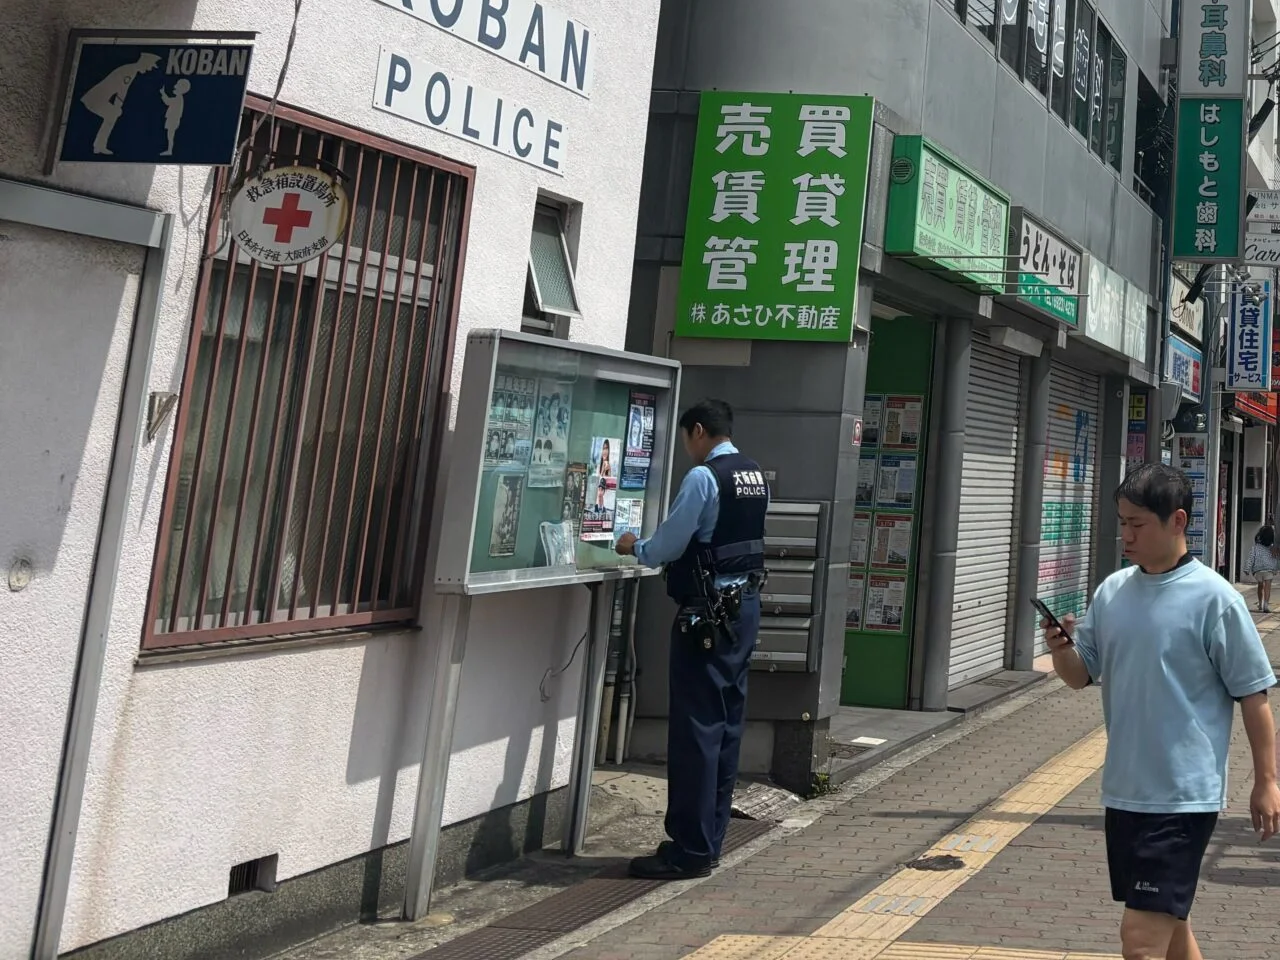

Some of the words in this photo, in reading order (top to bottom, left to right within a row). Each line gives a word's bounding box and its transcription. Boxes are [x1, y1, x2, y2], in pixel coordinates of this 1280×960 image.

[165, 48, 249, 76] KOBAN
[384, 53, 563, 169] POLICE
[714, 102, 851, 159] 売買
[246, 173, 340, 208] 救急箱設置場所
[707, 170, 846, 227] 賃貸
[1195, 103, 1221, 253] はしもと歯科
[238, 230, 281, 261] 日本赤十字社
[284, 236, 328, 261] 大阪府支部
[702, 235, 839, 292] 管理
[1022, 223, 1078, 290] うどん・そば
[1233, 372, 1262, 384] サービス
[733, 471, 764, 486] 大阪府警
[736, 486, 766, 496] POLICE
